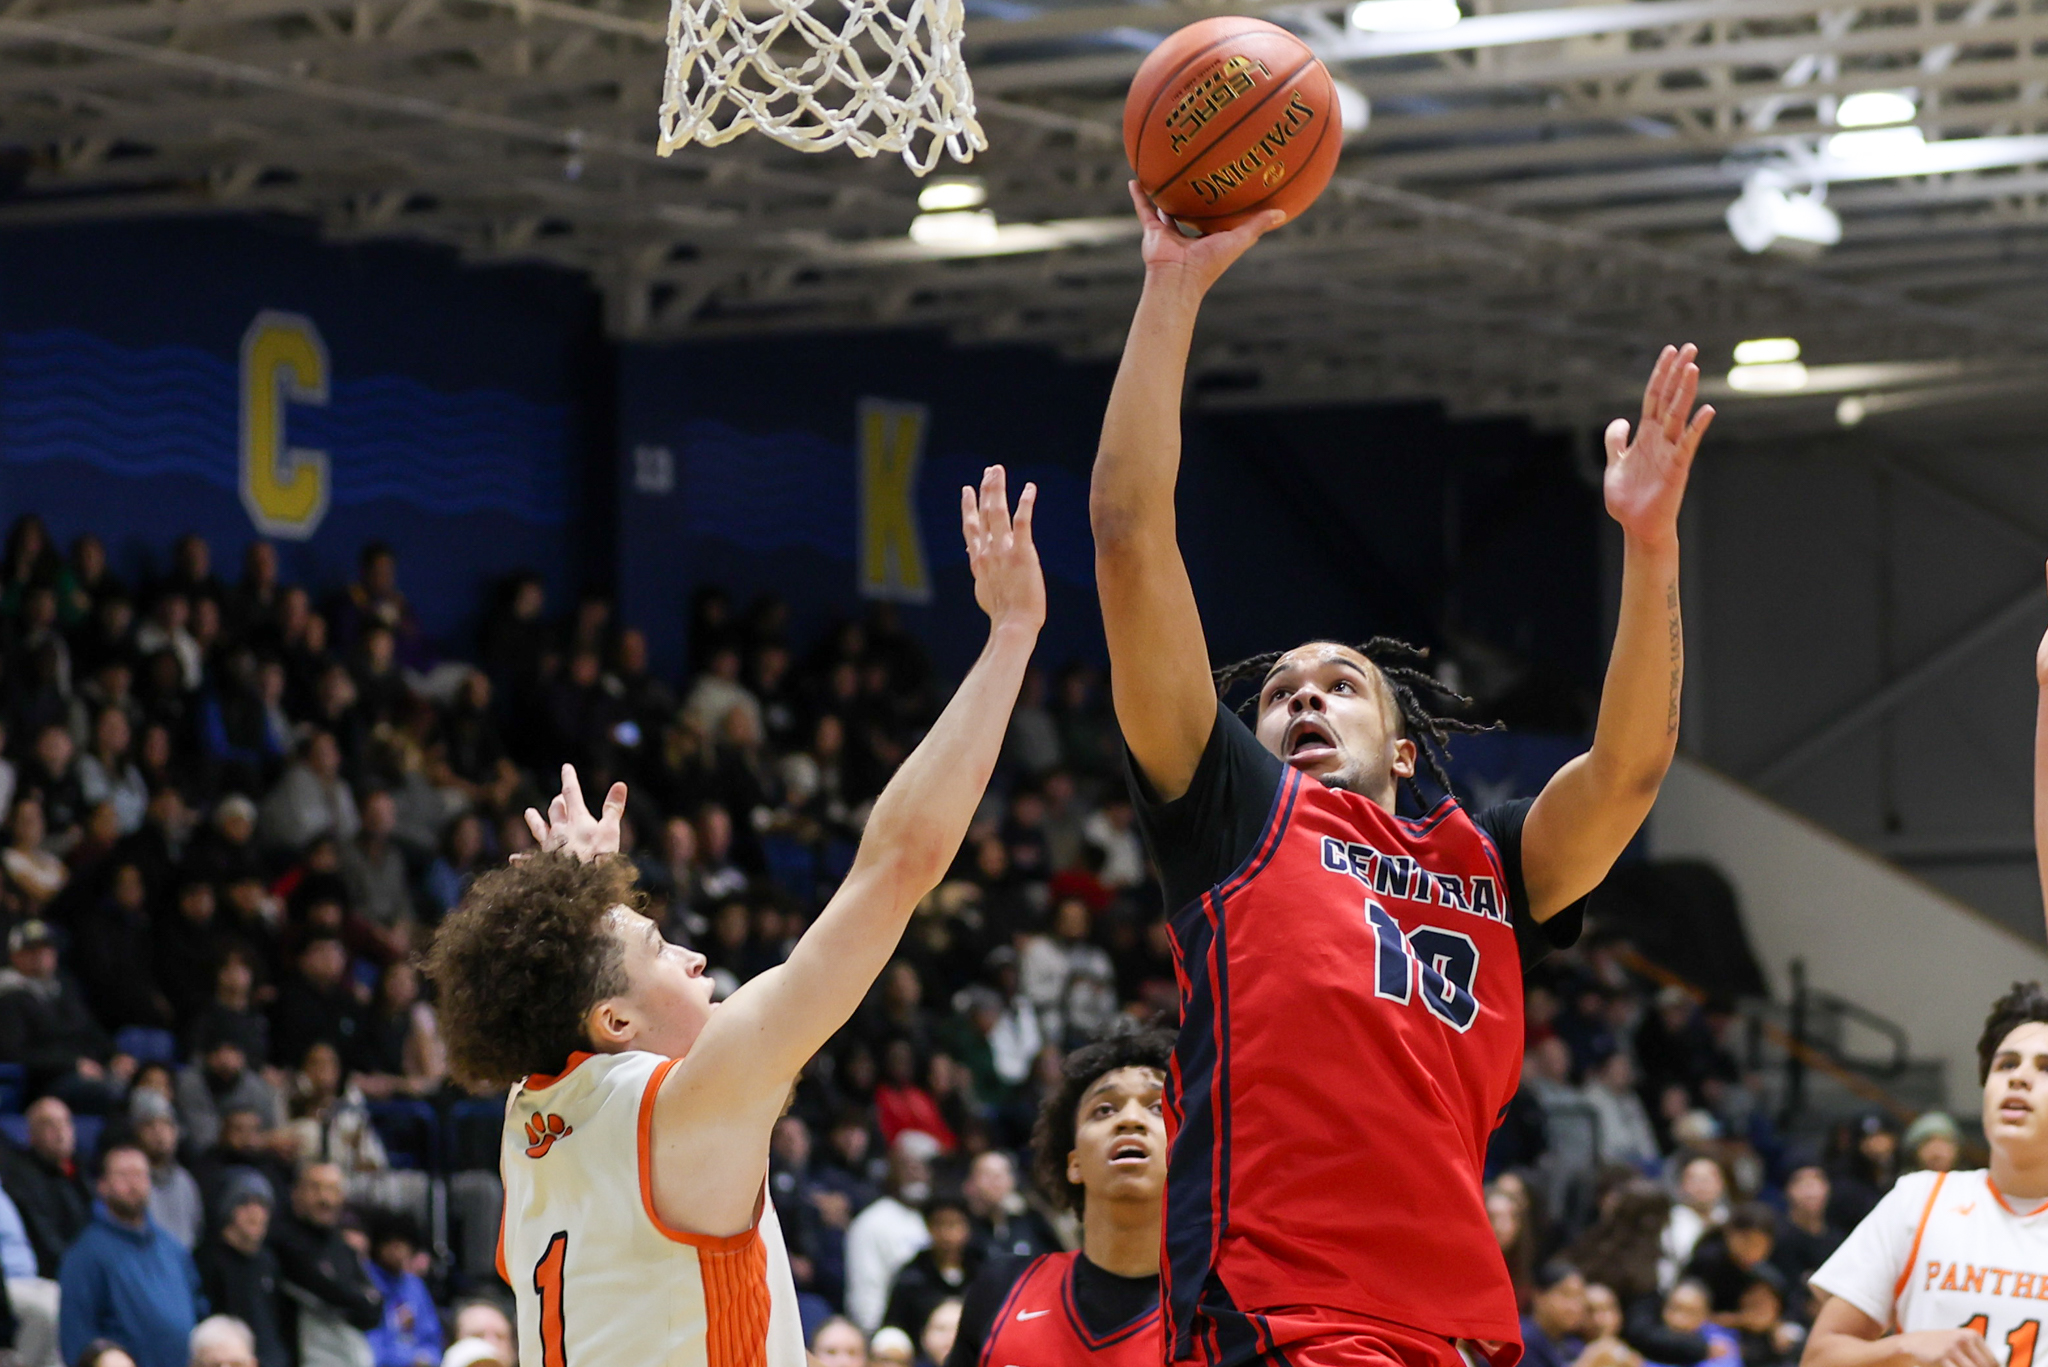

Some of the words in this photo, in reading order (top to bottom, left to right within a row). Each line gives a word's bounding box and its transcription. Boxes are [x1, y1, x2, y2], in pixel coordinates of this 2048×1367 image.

[1170, 59, 1272, 156] LEGACY
[1190, 89, 1315, 205] SPALDING
[239, 308, 331, 539] C
[857, 397, 932, 604] K
[1364, 898, 1480, 1034] 10
[533, 1230, 568, 1367] 1
[1924, 1260, 2048, 1300] PANTHE
[1957, 1313, 2040, 1367] 1
